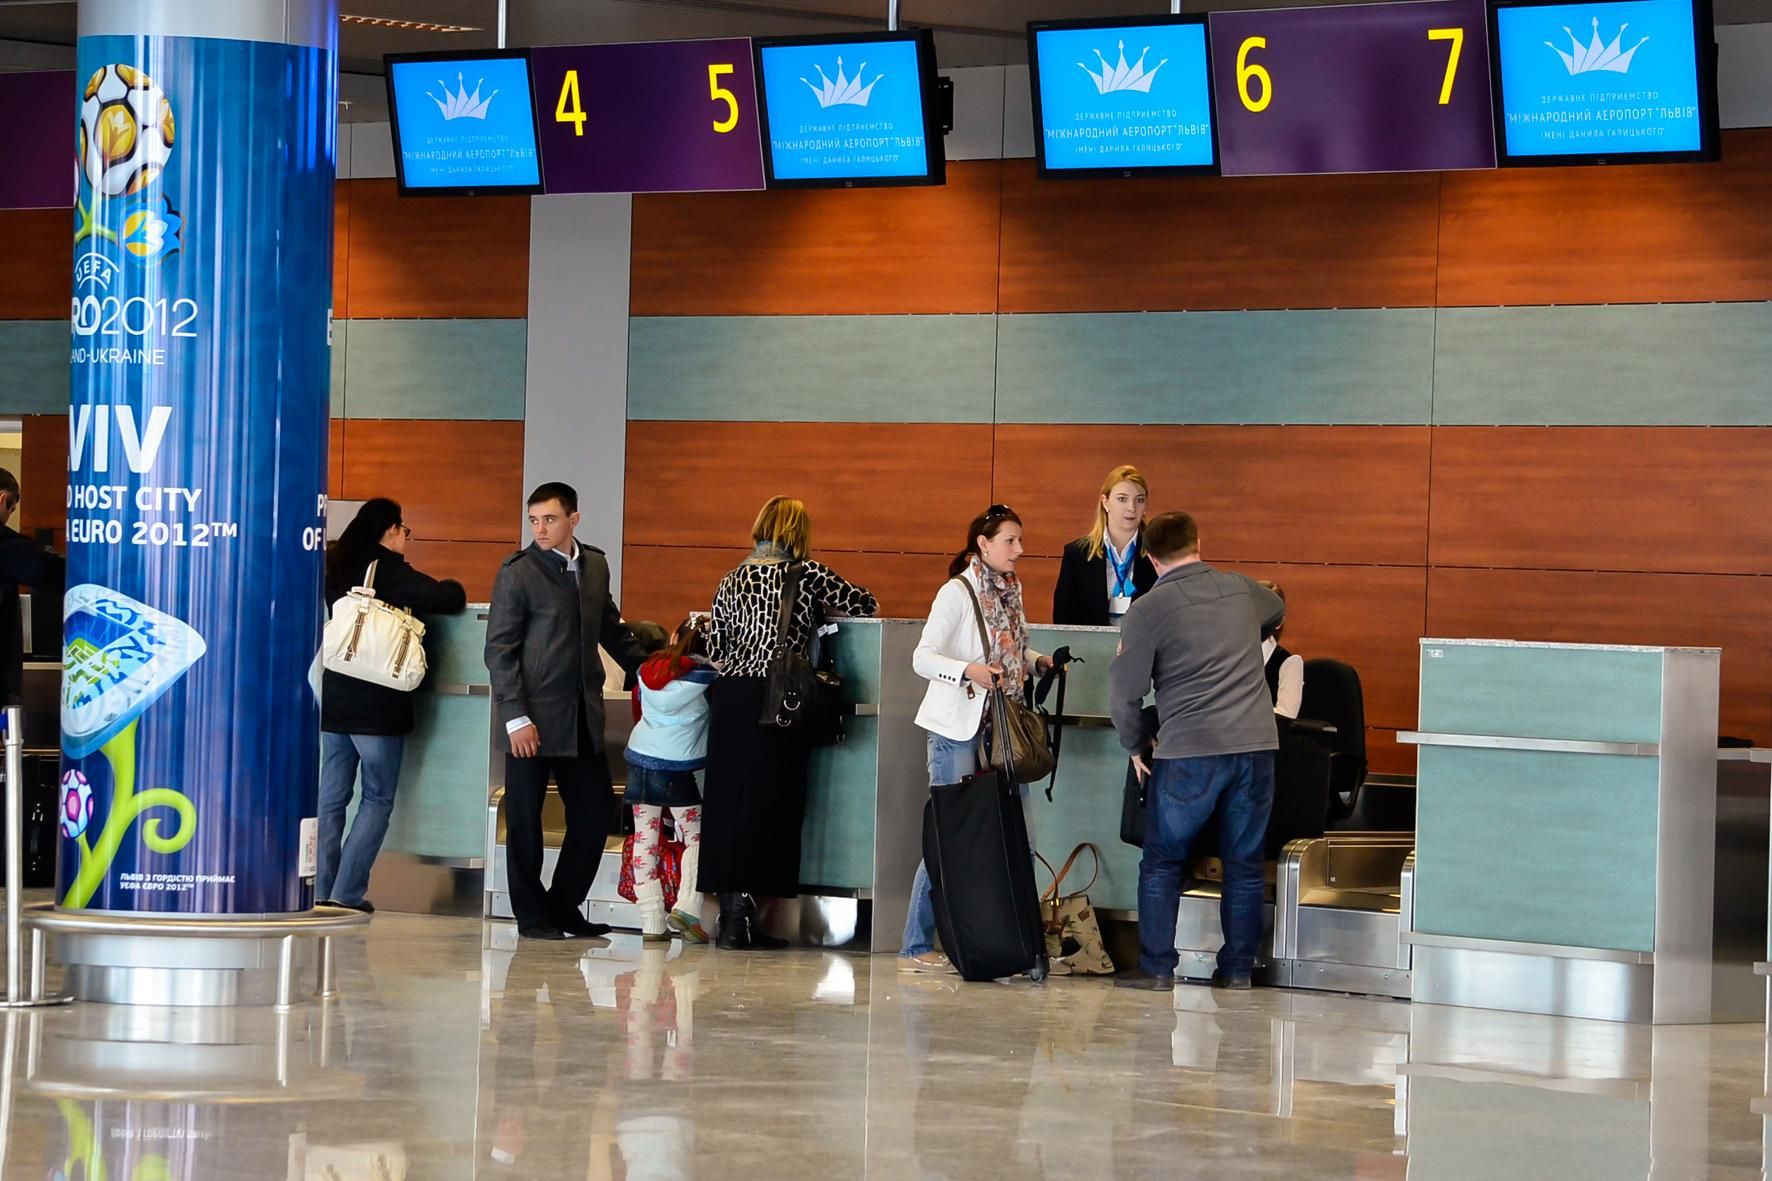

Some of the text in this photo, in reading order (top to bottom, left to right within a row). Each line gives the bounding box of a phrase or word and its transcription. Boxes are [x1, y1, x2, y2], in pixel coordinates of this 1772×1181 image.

[1236, 28, 1464, 113] 6 7
[555, 63, 739, 136] 4 5
[1596, 108, 1653, 121] АЕРОПОРТ
[844, 137, 889, 149] АЕРОПОРТ
[1122, 125, 1172, 137] АЕРОПОРТ
[76, 260, 113, 285] UEFA
[71, 347, 165, 365] AND-UKRAINE
[68, 404, 173, 473] VIV
[75, 485, 128, 510] HOST
[135, 486, 202, 512] CITY
[71, 519, 123, 544] EURO
[302, 526, 322, 551] OF
